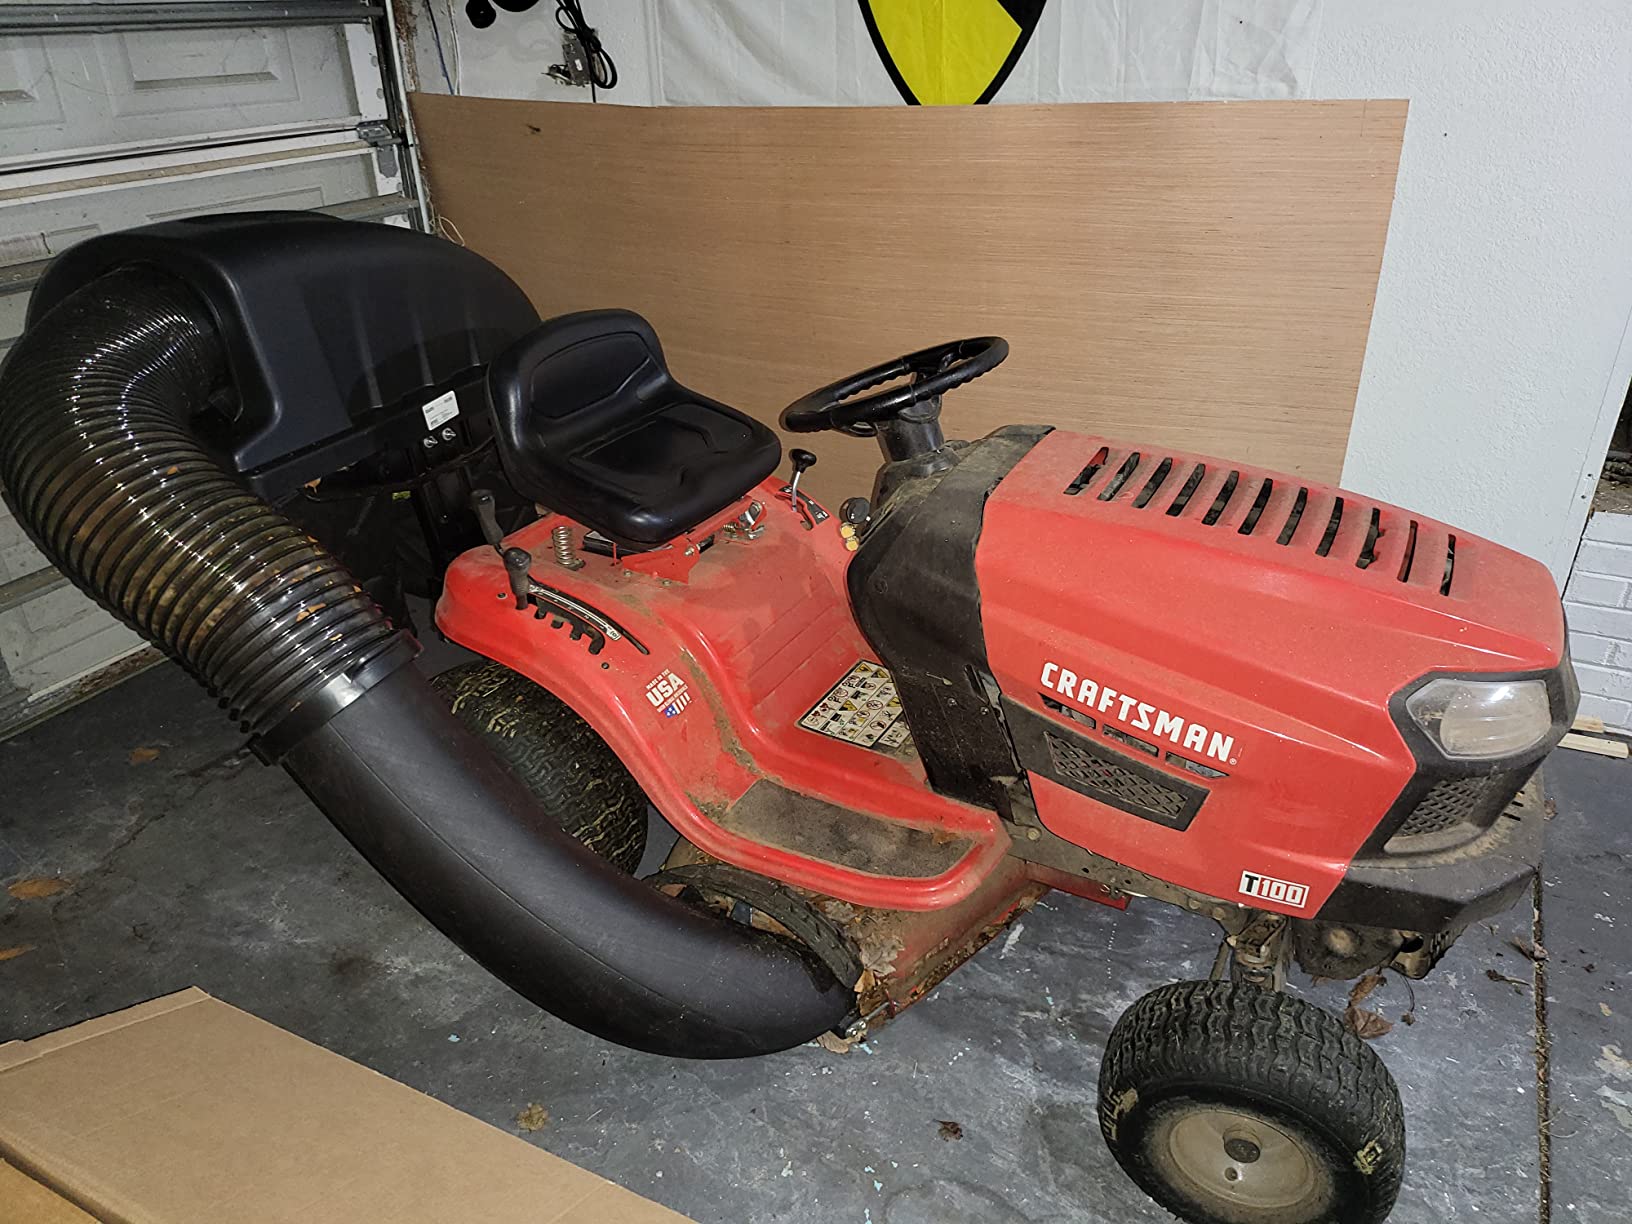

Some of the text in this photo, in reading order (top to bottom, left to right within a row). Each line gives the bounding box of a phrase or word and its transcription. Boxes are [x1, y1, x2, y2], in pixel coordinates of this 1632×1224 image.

[645, 672, 685, 707] USA
[1040, 662, 1235, 763] CRAFTSMAN
[1244, 874, 1303, 904] T100
